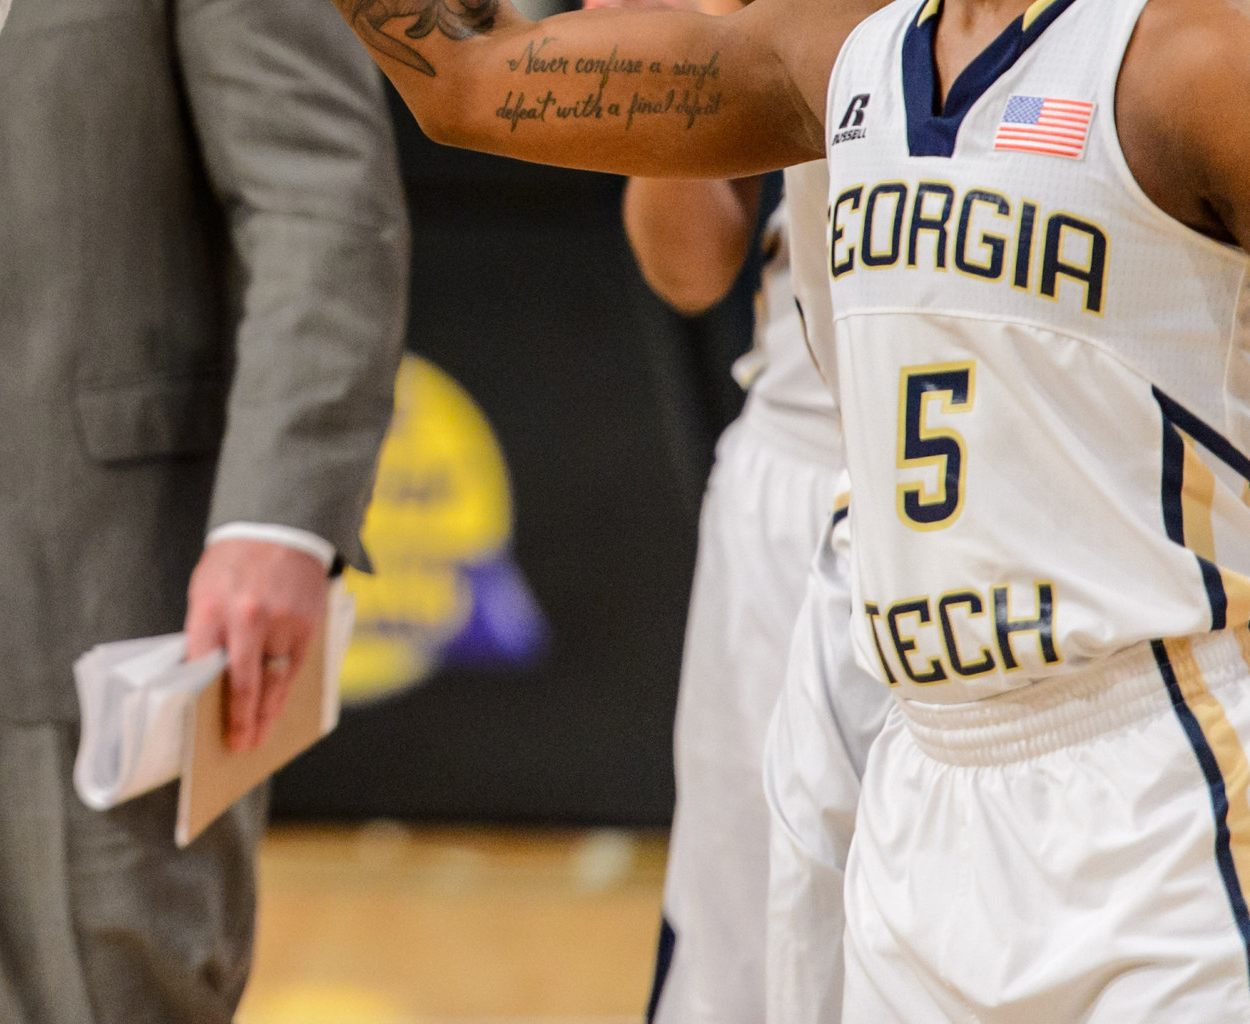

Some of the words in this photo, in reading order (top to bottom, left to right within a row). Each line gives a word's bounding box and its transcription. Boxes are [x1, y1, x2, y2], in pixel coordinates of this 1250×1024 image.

[496, 91, 556, 132] defeat
[557, 88, 602, 118] with
[608, 103, 619, 116] a
[625, 89, 675, 131] final
[675, 90, 722, 129] defeat
[507, 37, 568, 74] Never
[575, 43, 642, 89] confuse
[649, 61, 661, 73] a
[673, 50, 720, 90] single
[827, 178, 1111, 318] EORGIA
[896, 359, 977, 532] 5
[863, 580, 1065, 688] TECH
